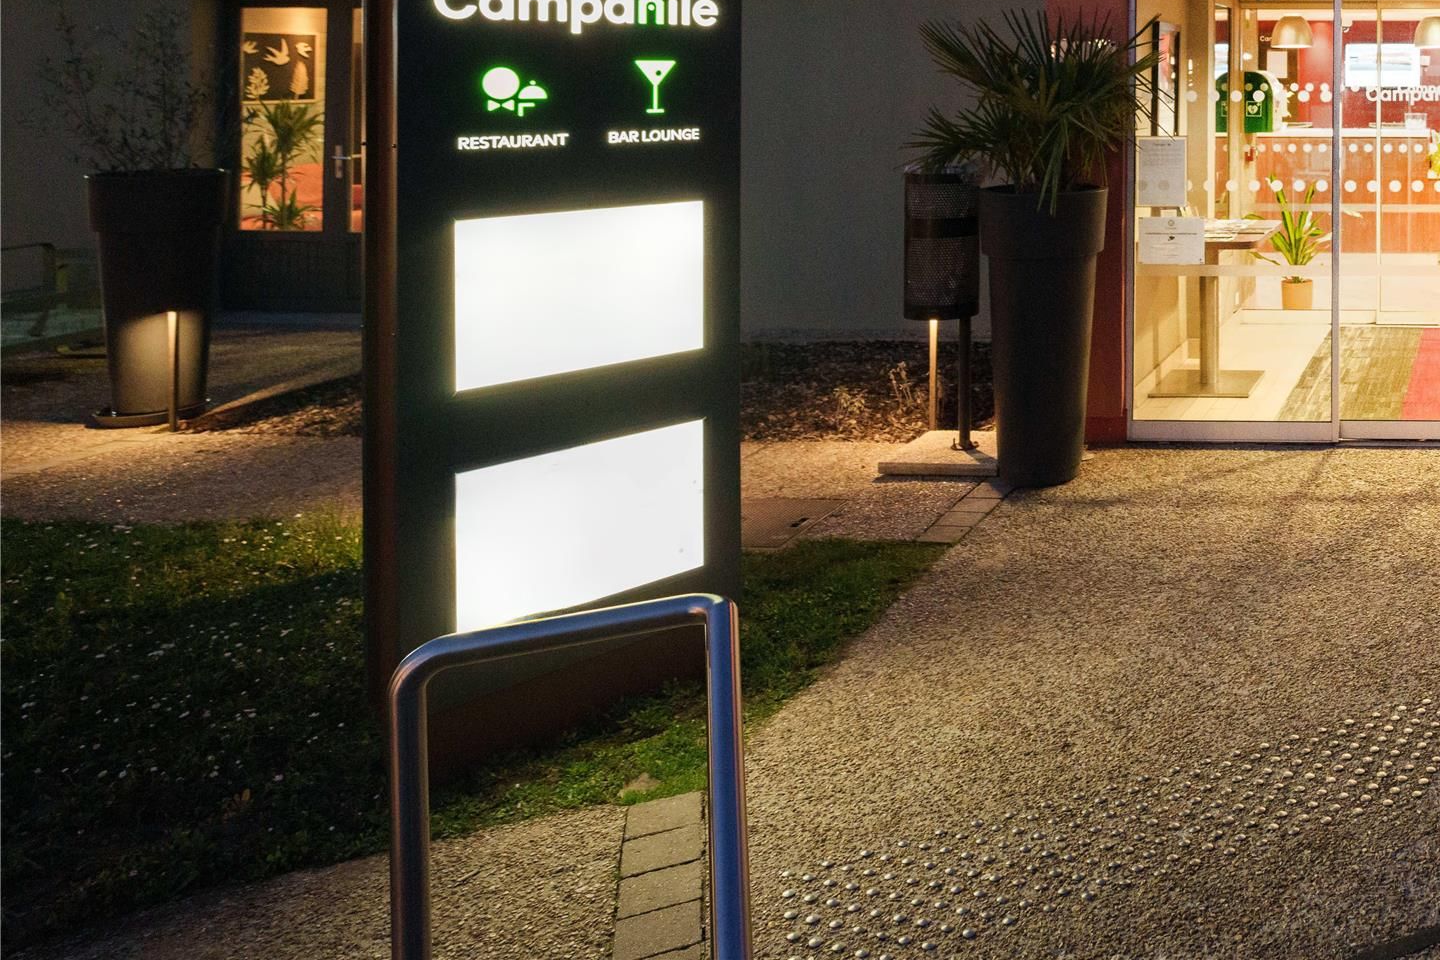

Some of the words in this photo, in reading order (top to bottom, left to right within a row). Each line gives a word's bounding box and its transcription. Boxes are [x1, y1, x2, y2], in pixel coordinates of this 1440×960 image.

[458, 133, 569, 150] RESTAURANT
[608, 131, 639, 144] BAR
[642, 128, 699, 142] LOUNGE
